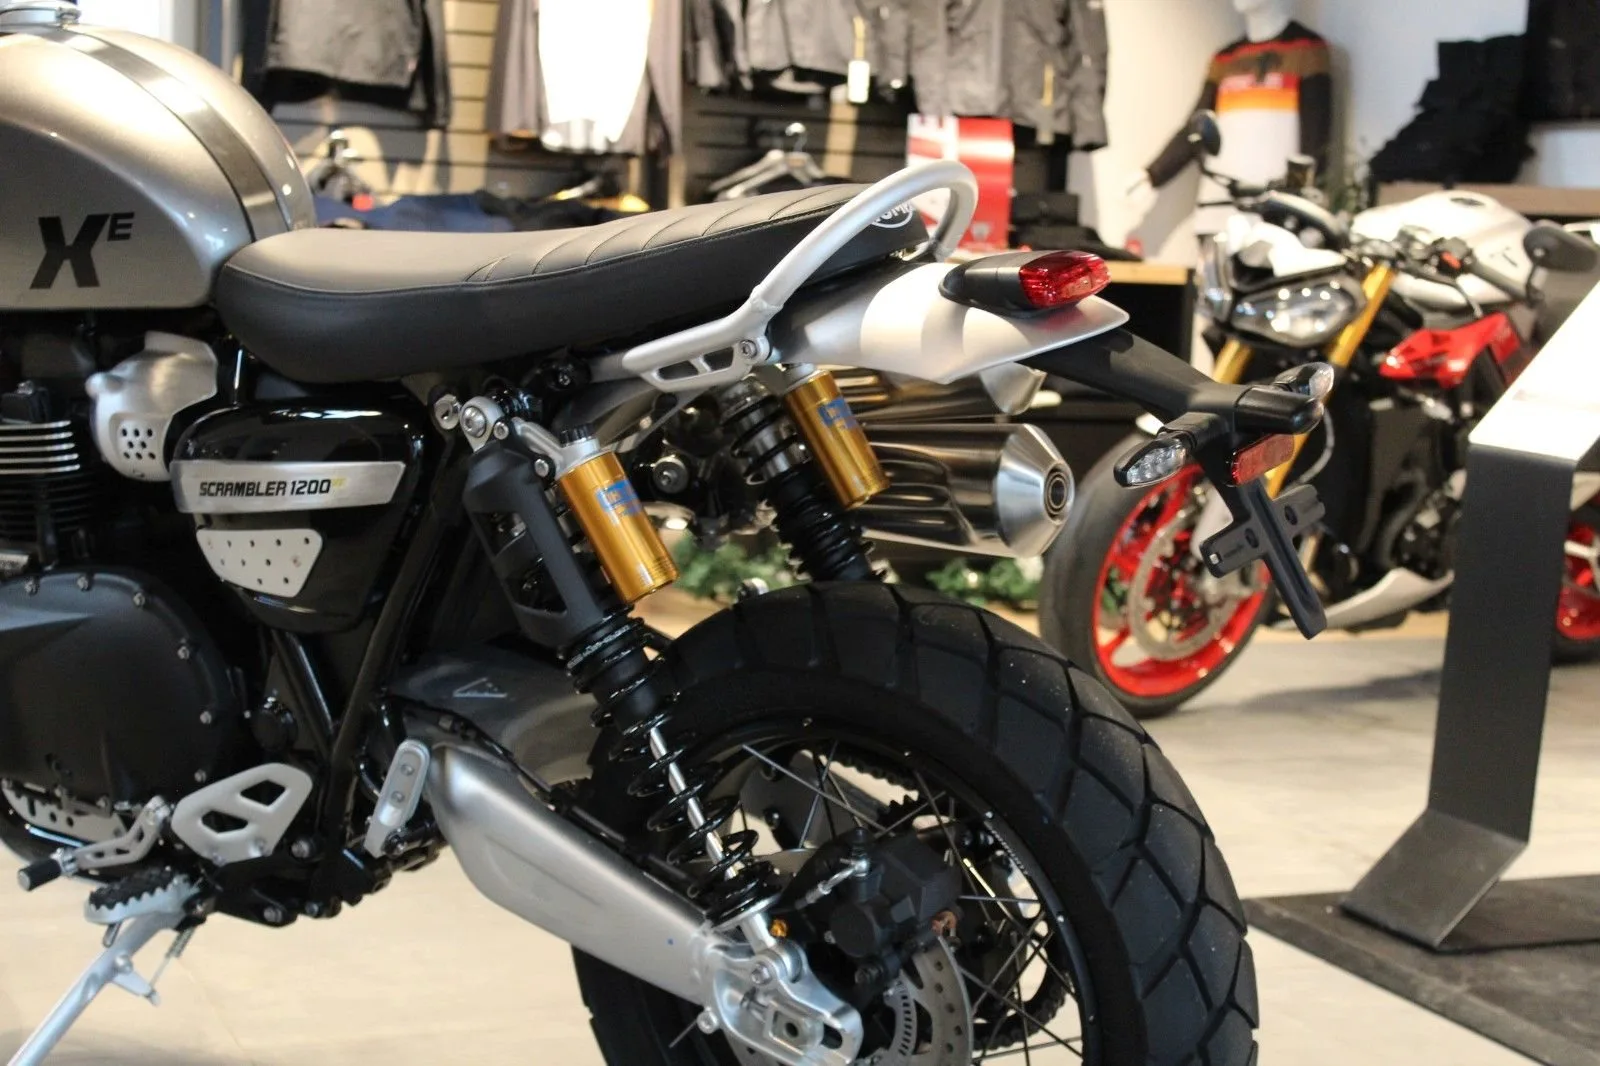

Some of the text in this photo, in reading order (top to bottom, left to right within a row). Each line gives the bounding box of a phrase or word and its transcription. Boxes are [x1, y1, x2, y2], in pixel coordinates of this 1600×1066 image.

[29, 211, 135, 290] XE
[199, 481, 287, 497] SCRAMBLER
[290, 479, 331, 495] 1200
